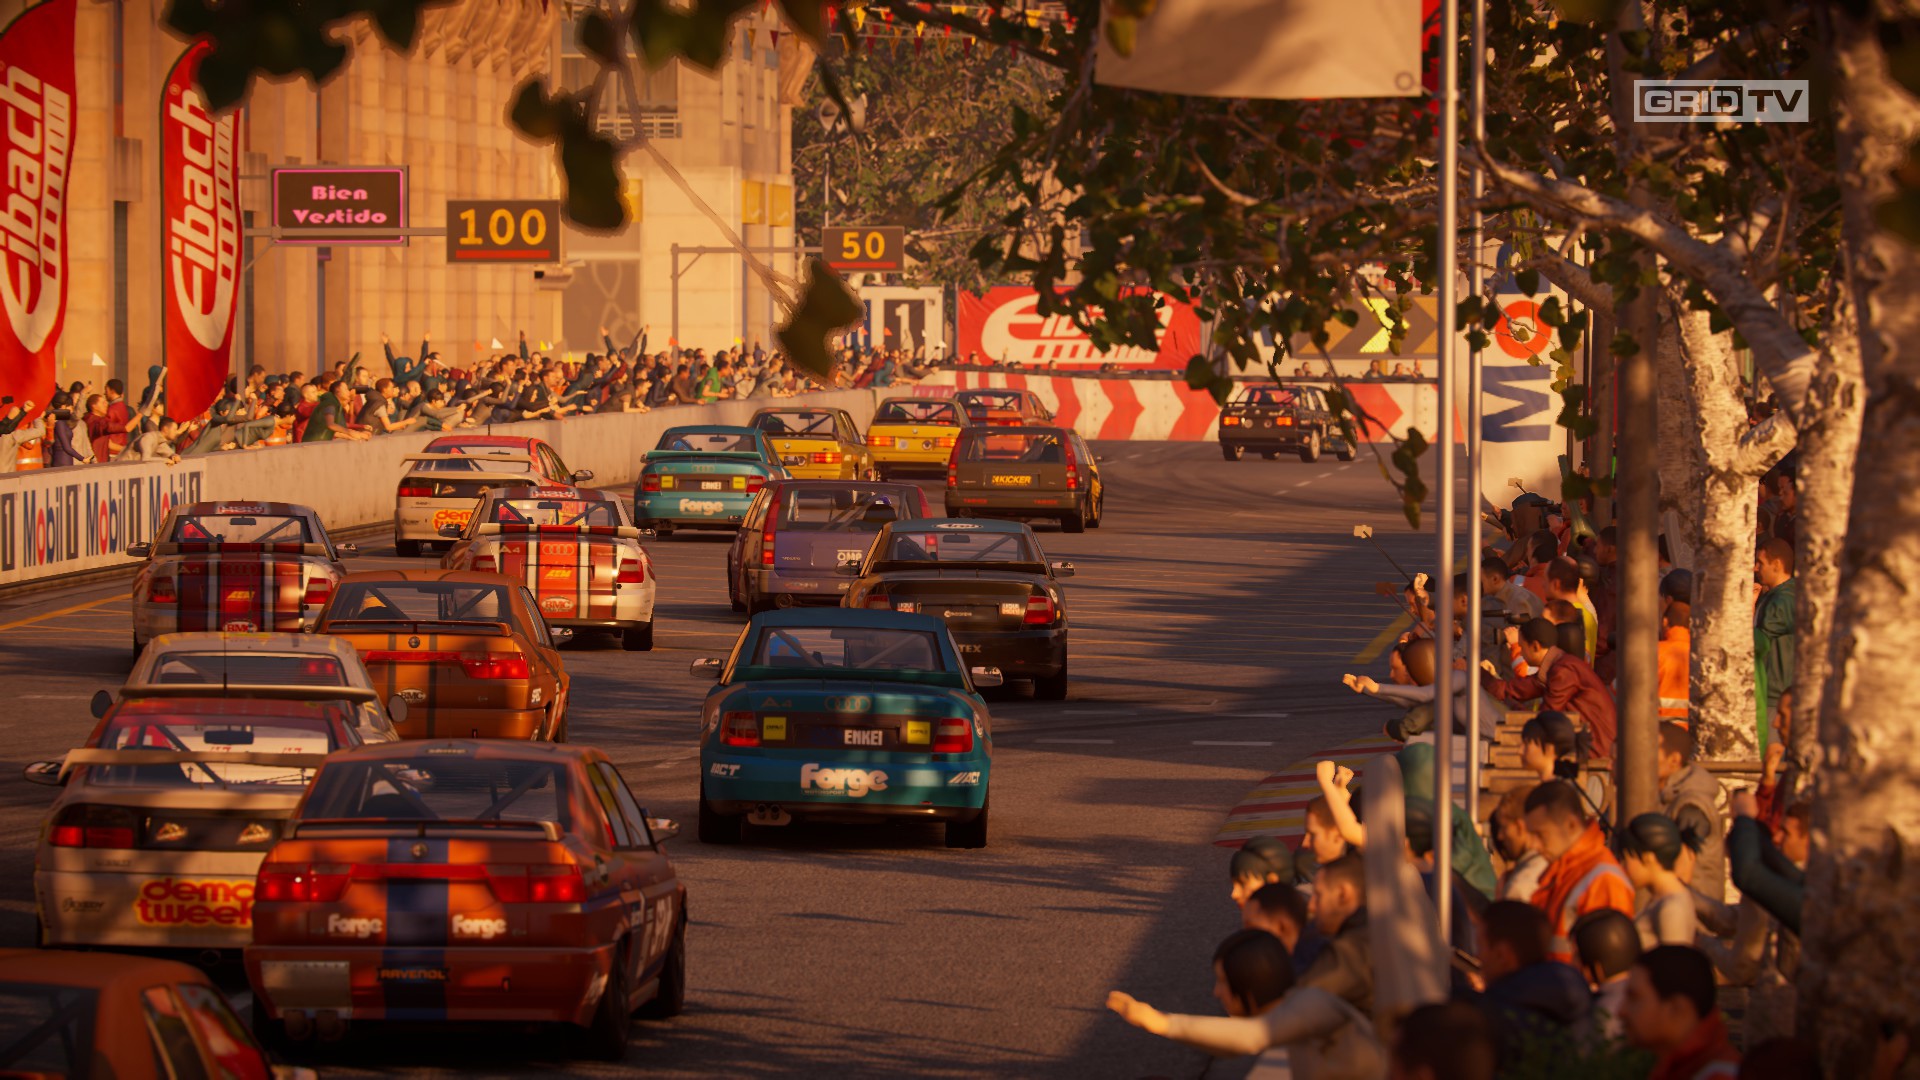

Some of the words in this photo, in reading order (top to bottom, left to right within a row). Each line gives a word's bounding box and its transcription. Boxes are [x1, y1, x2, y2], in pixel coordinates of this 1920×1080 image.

[311, 185, 368, 200] Bien
[292, 208, 387, 224] Vestido
[459, 208, 546, 245] 100
[842, 231, 885, 259] 50
[701, 481, 722, 490] ENKEI
[998, 476, 1032, 484] KICKER
[679, 498, 724, 515] Forge
[23, 487, 63, 568] Mobil
[67, 486, 78, 558] 1
[86, 480, 126, 557] Mobil
[500, 545, 520, 553] A4
[837, 552, 862, 561] OMP
[544, 600, 571, 609] BMC
[844, 729, 883, 746] ENKEI
[800, 763, 889, 797] Forge
[328, 914, 383, 938] Forge
[452, 915, 507, 938] Forge
[380, 969, 446, 979] RAVENOL
